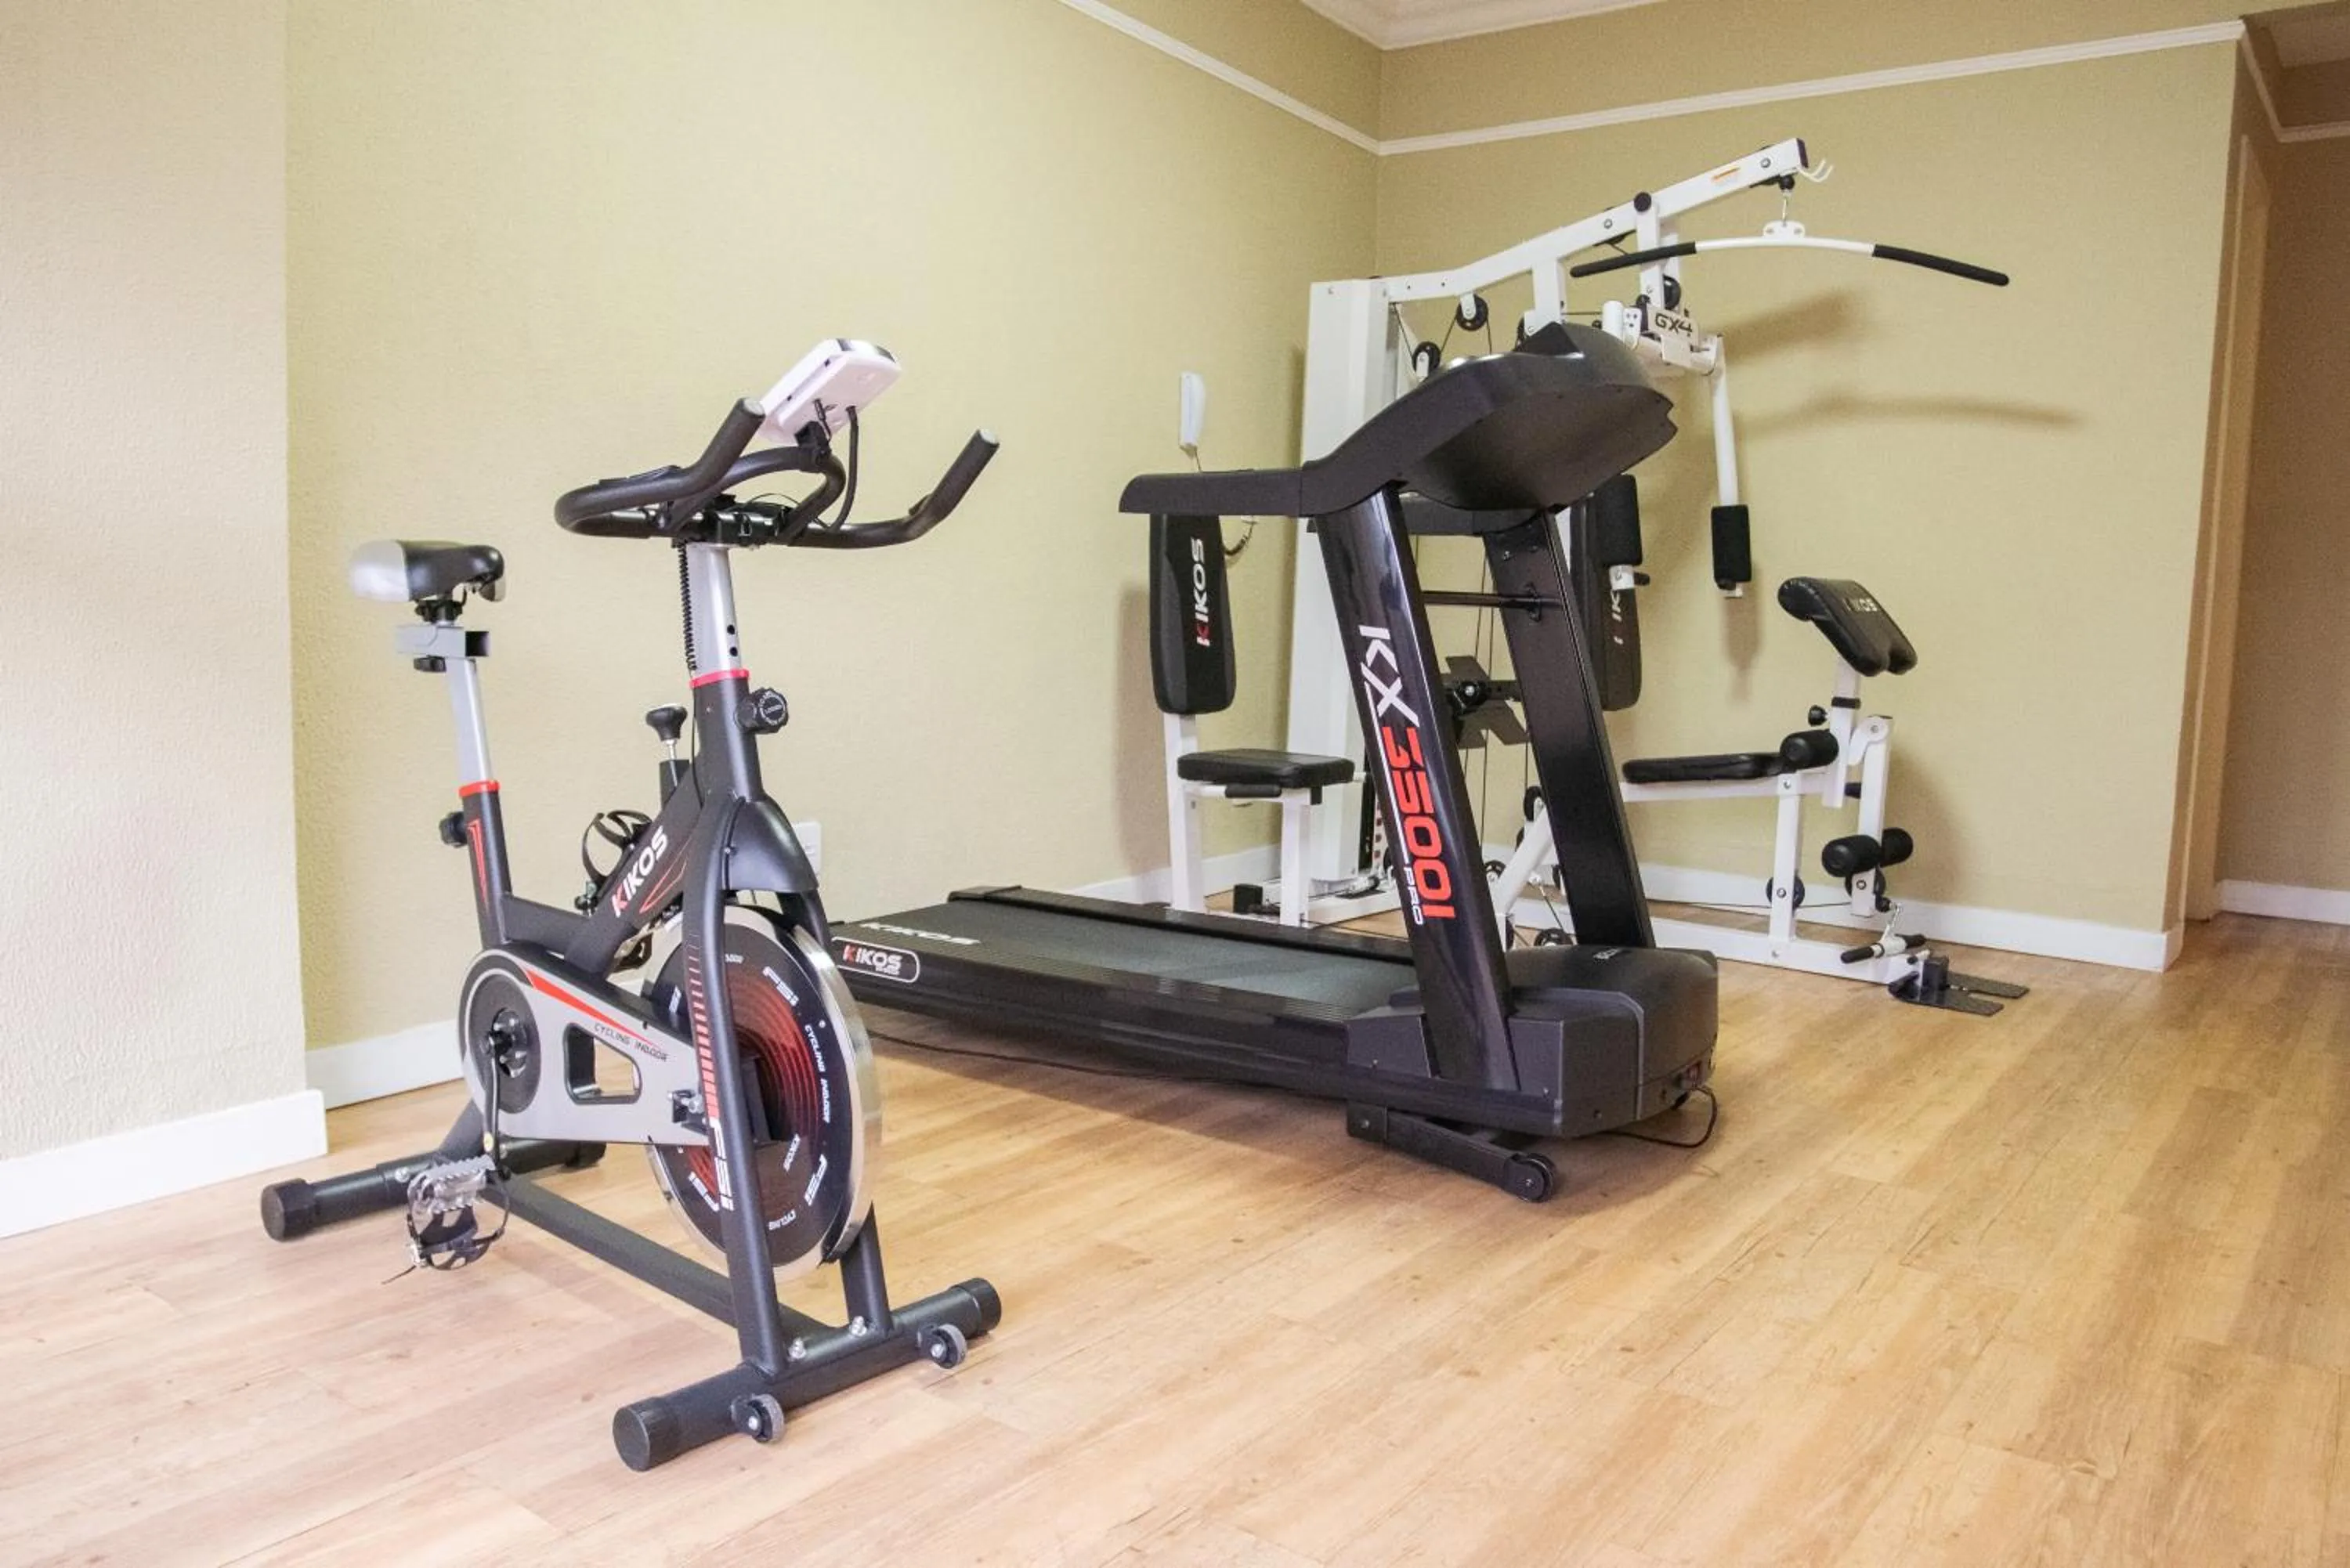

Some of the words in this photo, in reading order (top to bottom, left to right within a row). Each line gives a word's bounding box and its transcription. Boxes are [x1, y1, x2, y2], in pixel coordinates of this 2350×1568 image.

[1655, 313, 1693, 337] GX4
[1190, 536, 1210, 647] KIKOS
[612, 825, 668, 918] KIKOS
[1403, 866, 1423, 925] PRO
[842, 943, 903, 971] KIKOS
[595, 1023, 631, 1046] CYCLING
[804, 1024, 826, 1072] CYCLING
